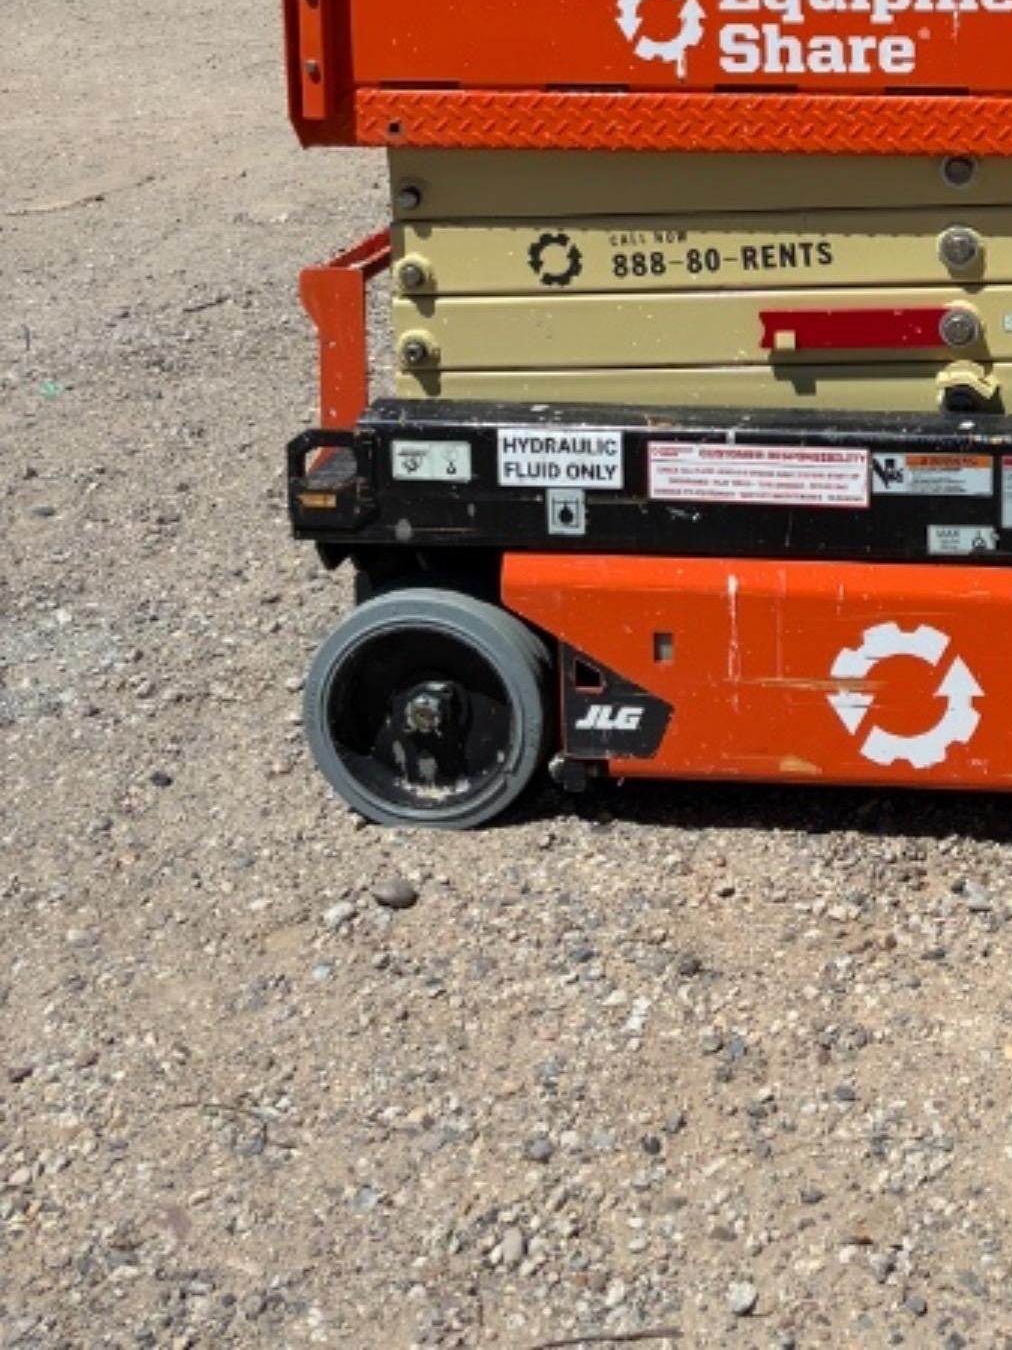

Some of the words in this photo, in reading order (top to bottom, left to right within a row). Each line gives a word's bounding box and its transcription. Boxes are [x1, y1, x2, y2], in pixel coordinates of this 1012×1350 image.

[719, 23, 916, 74] Share
[611, 242, 833, 278] 888-80-RENTS
[503, 437, 617, 456] HYDRAULIC
[503, 462, 560, 479] FLUID
[566, 464, 617, 480] ONLY
[575, 704, 644, 730] JLG
